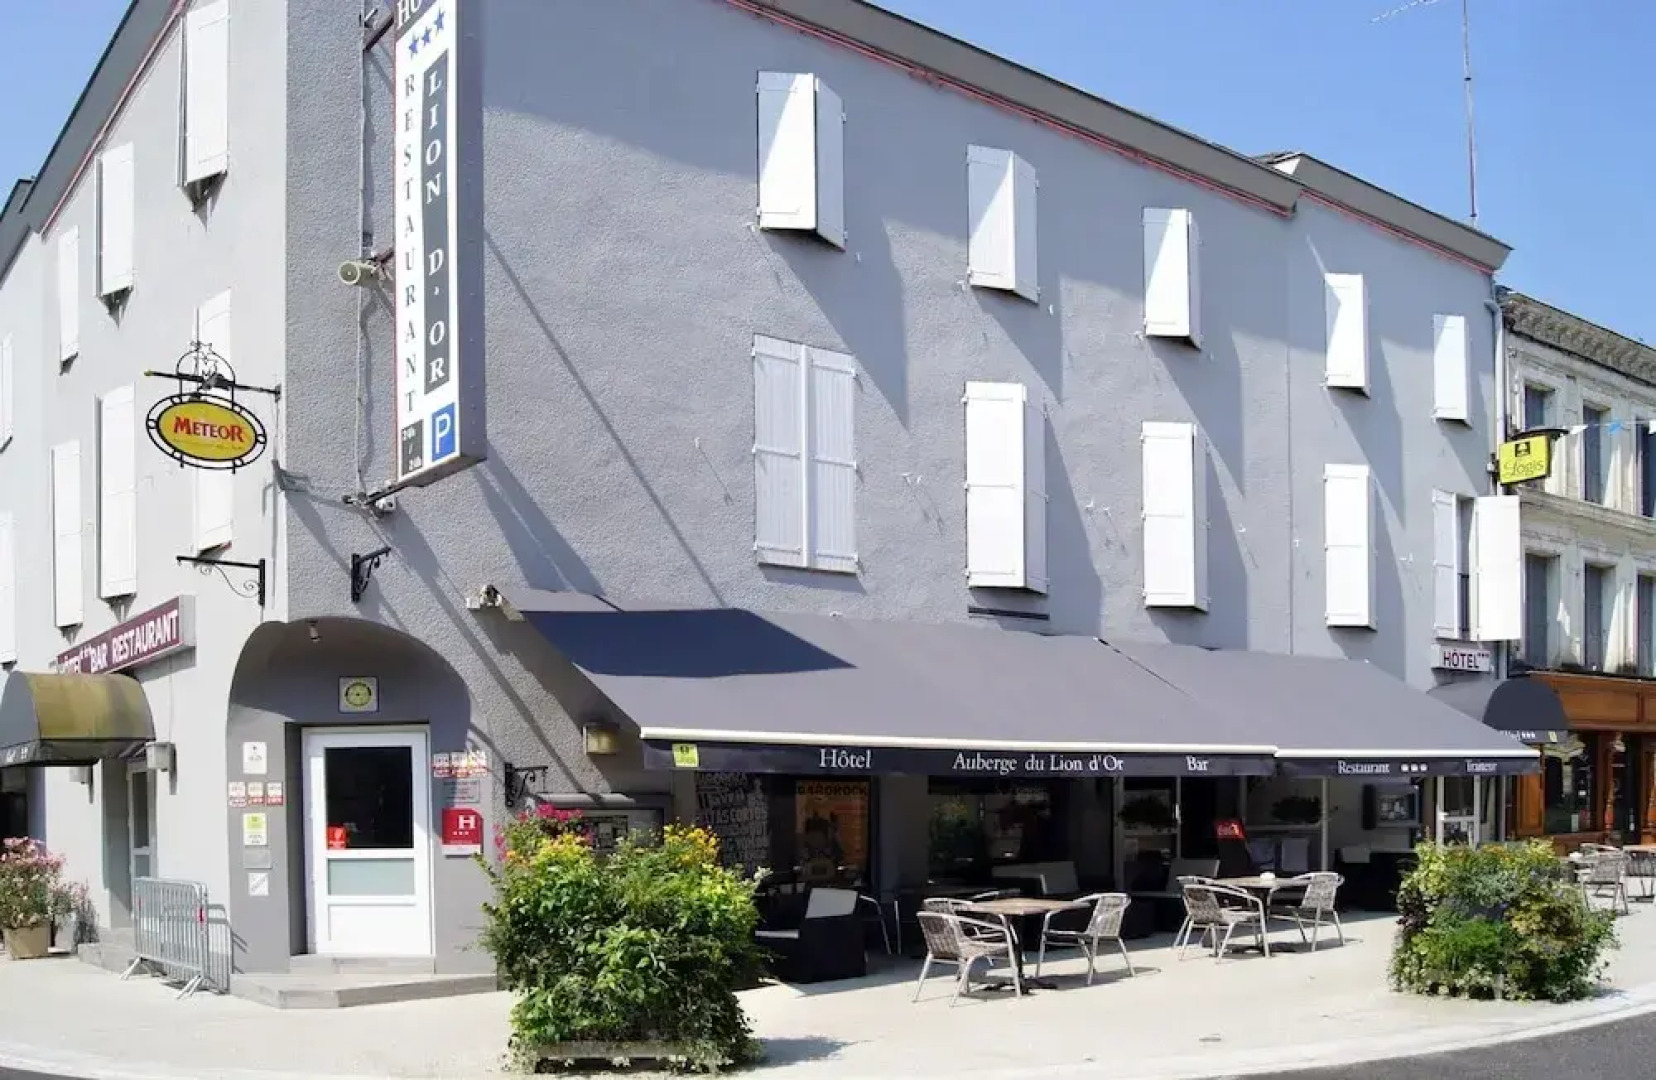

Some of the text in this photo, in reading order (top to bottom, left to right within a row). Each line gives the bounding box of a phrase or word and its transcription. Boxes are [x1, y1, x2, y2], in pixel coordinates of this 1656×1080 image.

[425, 70, 443, 205] LION
[403, 73, 417, 412] RESTAURANT
[436, 412, 451, 455] P
[90, 642, 108, 674] BAR
[112, 610, 178, 664] RESTAURANT
[1443, 649, 1480, 669] HÔTEL
[819, 748, 872, 769] Hôtel
[952, 752, 1123, 776] Auberge du Lion d'Or
[1186, 756, 1209, 772] Bar
[1338, 759, 1390, 775] Restaurant
[458, 814, 476, 829] H
